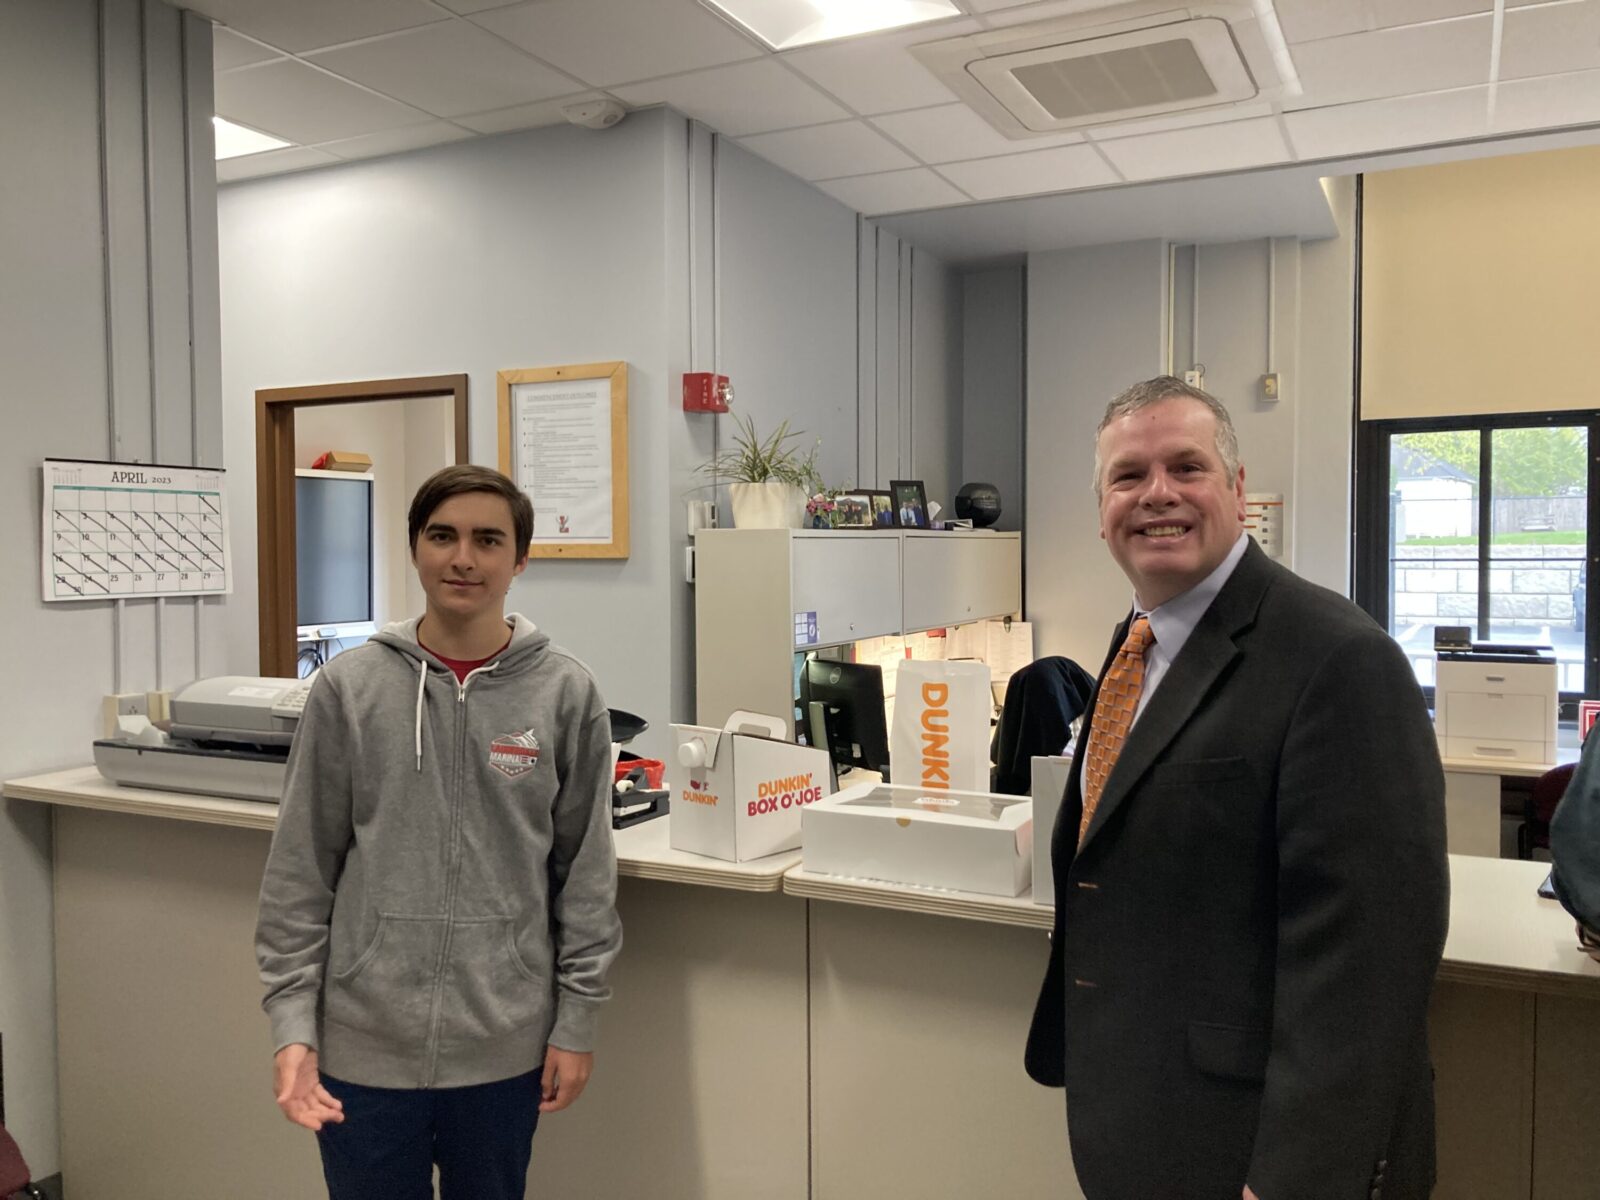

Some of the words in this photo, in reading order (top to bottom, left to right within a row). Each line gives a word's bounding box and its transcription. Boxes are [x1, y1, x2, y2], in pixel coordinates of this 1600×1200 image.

[111, 471, 147, 484] APRIL
[180, 513, 185, 521] 7
[57, 533, 62, 541] 9
[82, 533, 90, 541] 10
[157, 573, 165, 581] 27
[920, 682, 950, 793] DUNKI
[758, 772, 813, 799] DUNKIN'
[683, 790, 719, 807] DUNKIN'
[747, 796, 778, 817] BOX
